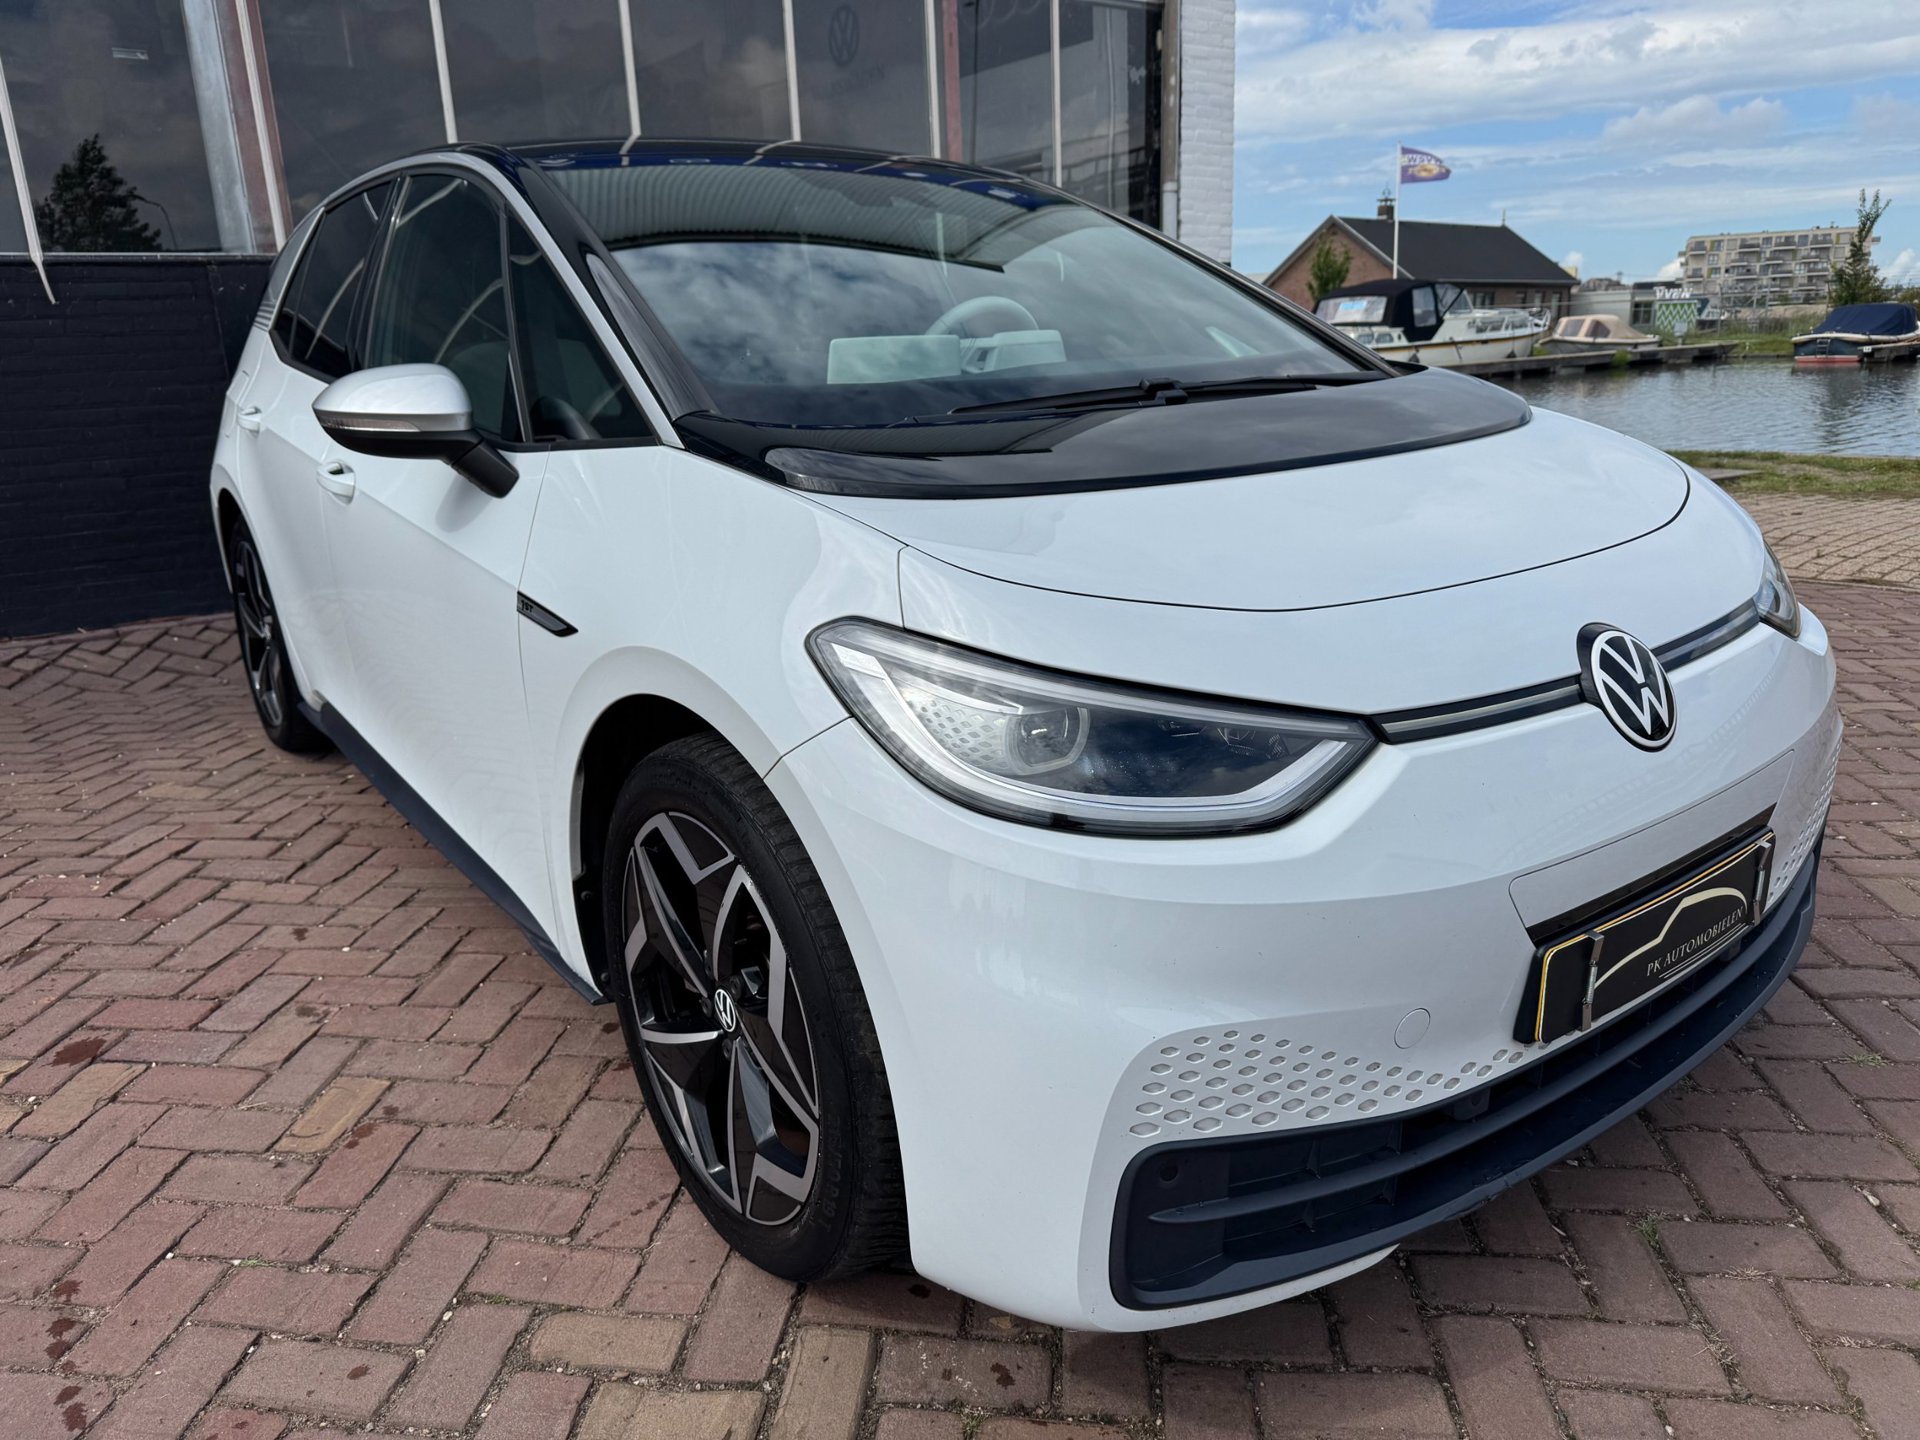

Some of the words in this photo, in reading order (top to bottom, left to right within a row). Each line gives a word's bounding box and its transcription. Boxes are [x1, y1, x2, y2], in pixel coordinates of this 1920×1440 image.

[1591, 630, 1676, 748] VW
[1646, 956, 1662, 977] PK
[1664, 906, 1744, 967] AUTOMOBIELEN
